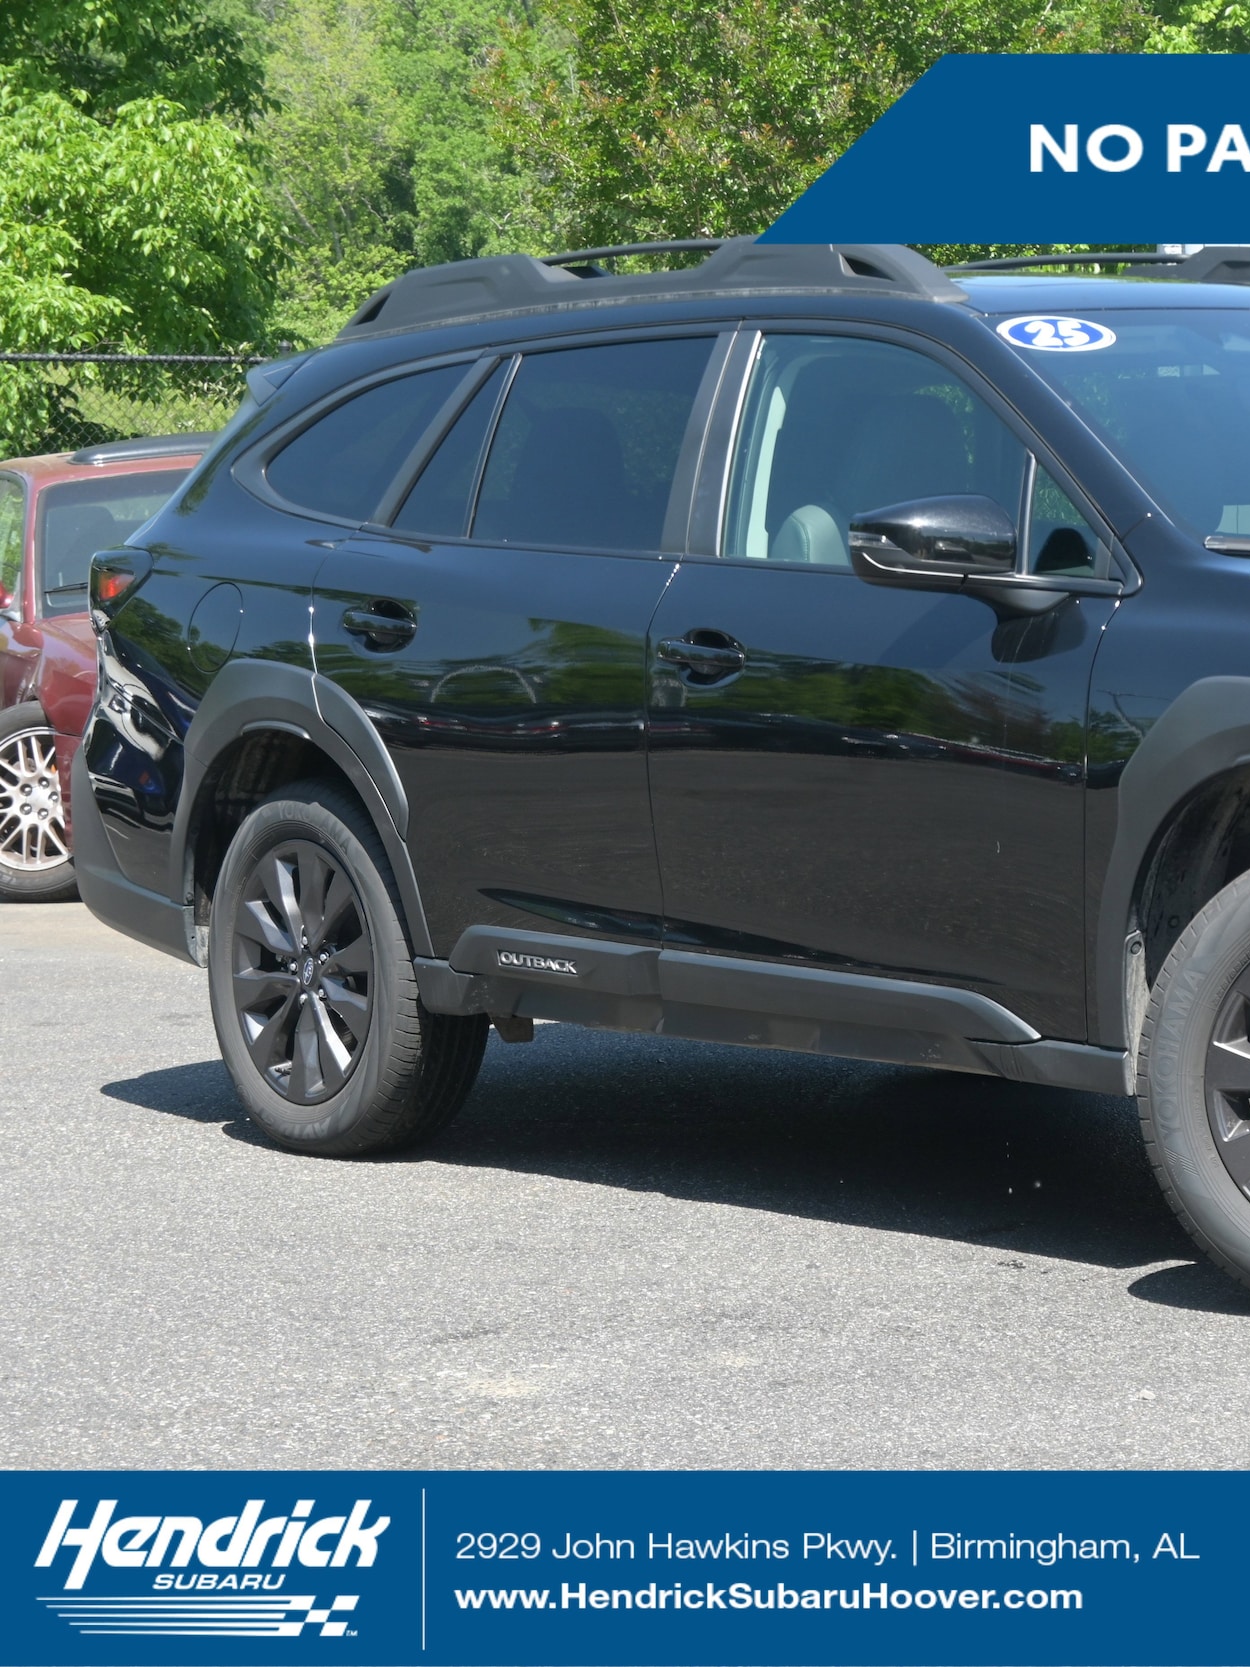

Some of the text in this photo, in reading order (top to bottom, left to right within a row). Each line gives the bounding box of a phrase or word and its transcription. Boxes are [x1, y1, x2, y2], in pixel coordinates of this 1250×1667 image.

[1024, 321, 1090, 347] 25
[499, 950, 578, 974] OUTBACK
[1154, 968, 1207, 1142] YOKOHAMA
